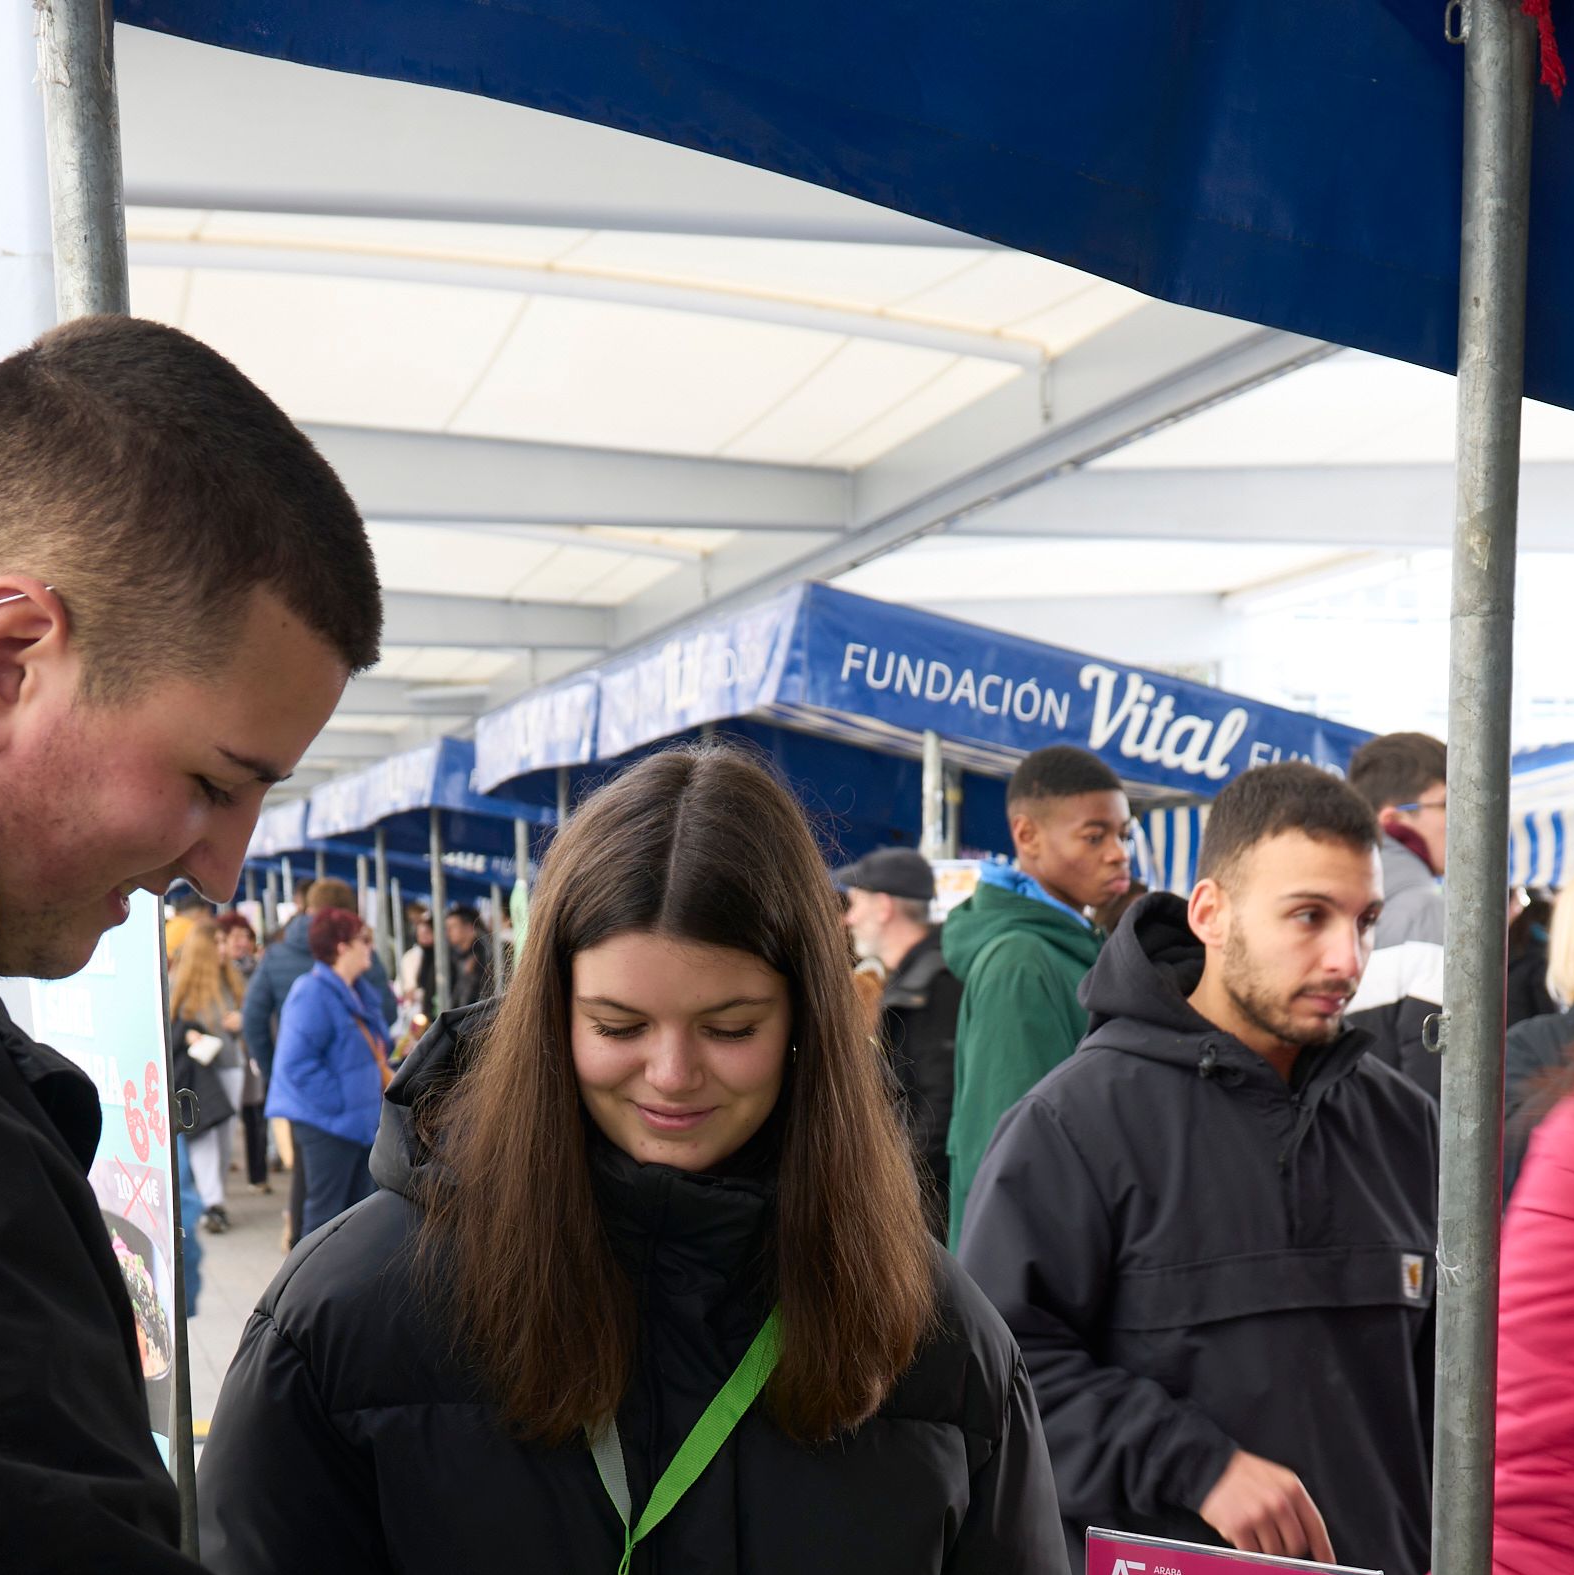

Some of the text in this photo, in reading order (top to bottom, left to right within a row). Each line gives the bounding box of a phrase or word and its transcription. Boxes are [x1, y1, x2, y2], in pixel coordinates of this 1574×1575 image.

[841, 642, 1070, 730] FUNDACIÓN
[1078, 663, 1248, 780] Vital
[123, 1060, 166, 1163] 6€
